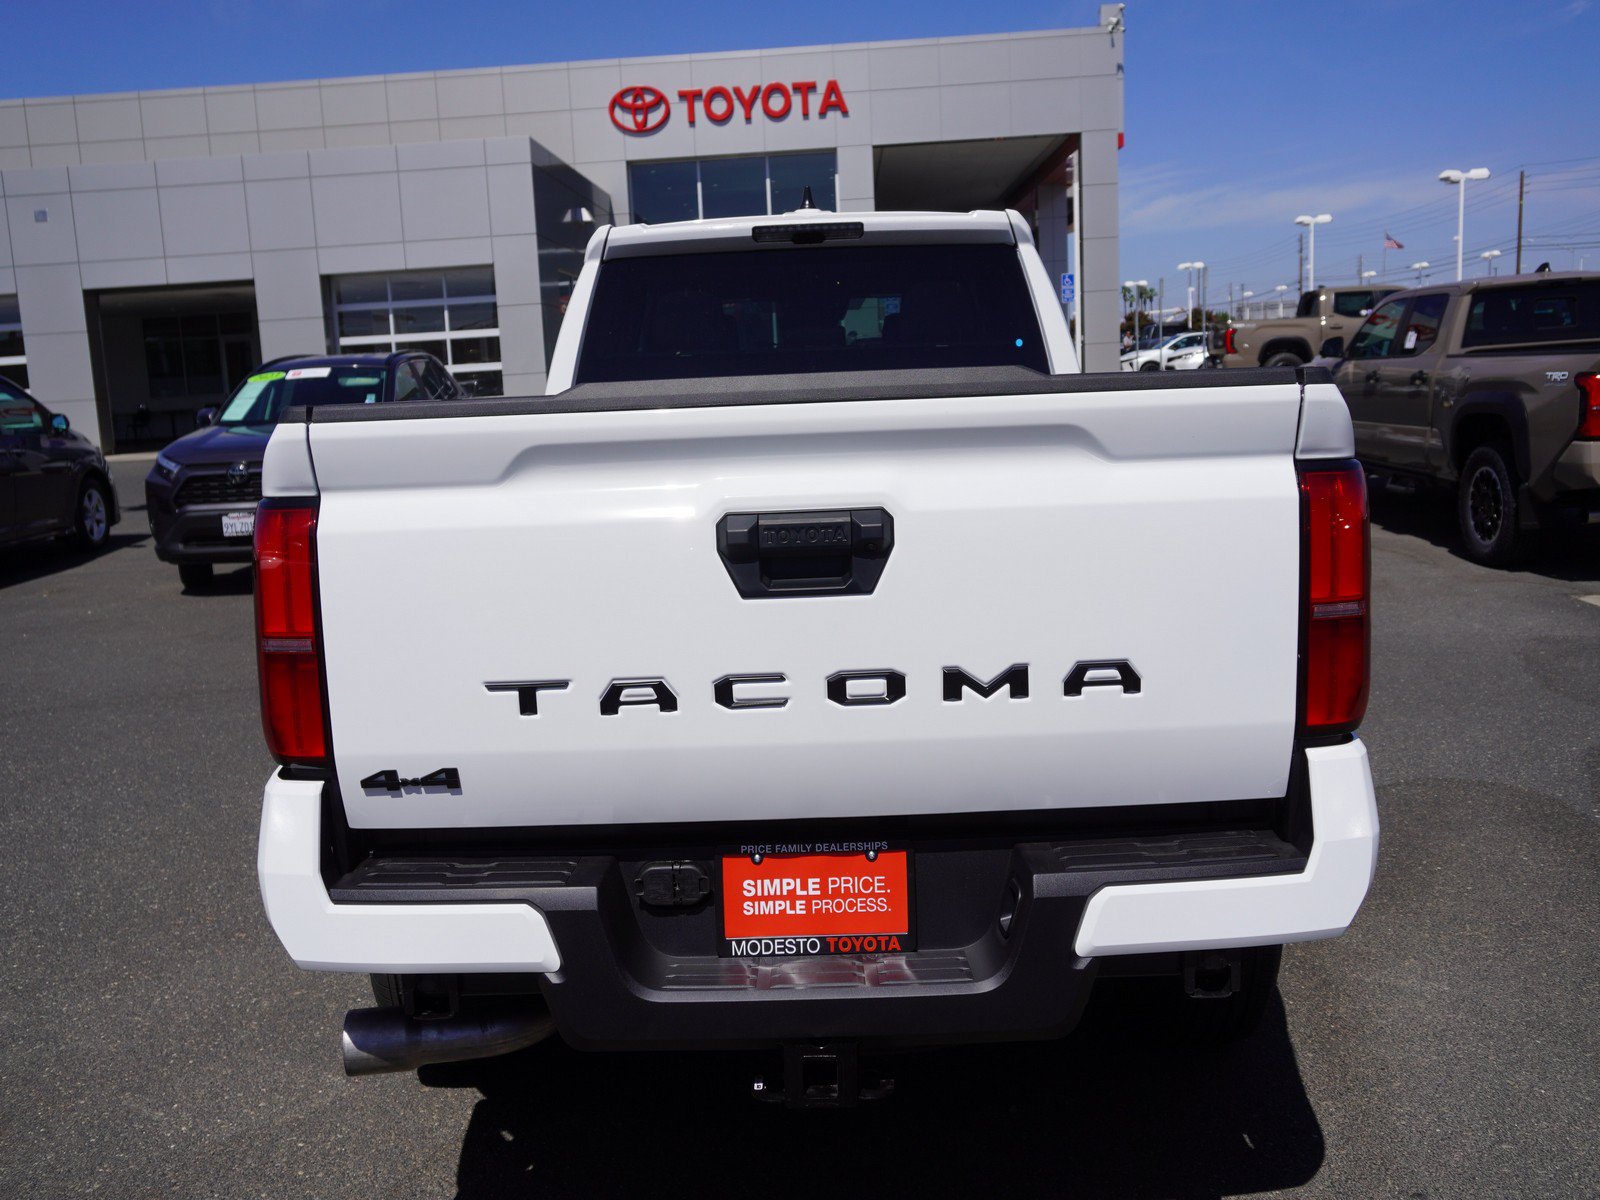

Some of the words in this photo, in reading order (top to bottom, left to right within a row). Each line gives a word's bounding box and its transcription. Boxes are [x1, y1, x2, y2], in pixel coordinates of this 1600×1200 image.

[677, 79, 849, 127] TOYOTA
[1545, 371, 1569, 381] TRD
[763, 526, 848, 545] TOYOTA
[483, 659, 1142, 716] TACOMA
[741, 844, 772, 854] PRICE
[775, 843, 813, 853] FAMILY
[815, 841, 889, 852] DEALERSHIPS
[742, 877, 821, 897] SIMPLE
[828, 876, 891, 894] PRICE.
[743, 900, 806, 915] SIMPLE
[811, 897, 892, 914] PROCESS.
[731, 938, 820, 956] MODESTO
[826, 936, 901, 953] TOYOTA
